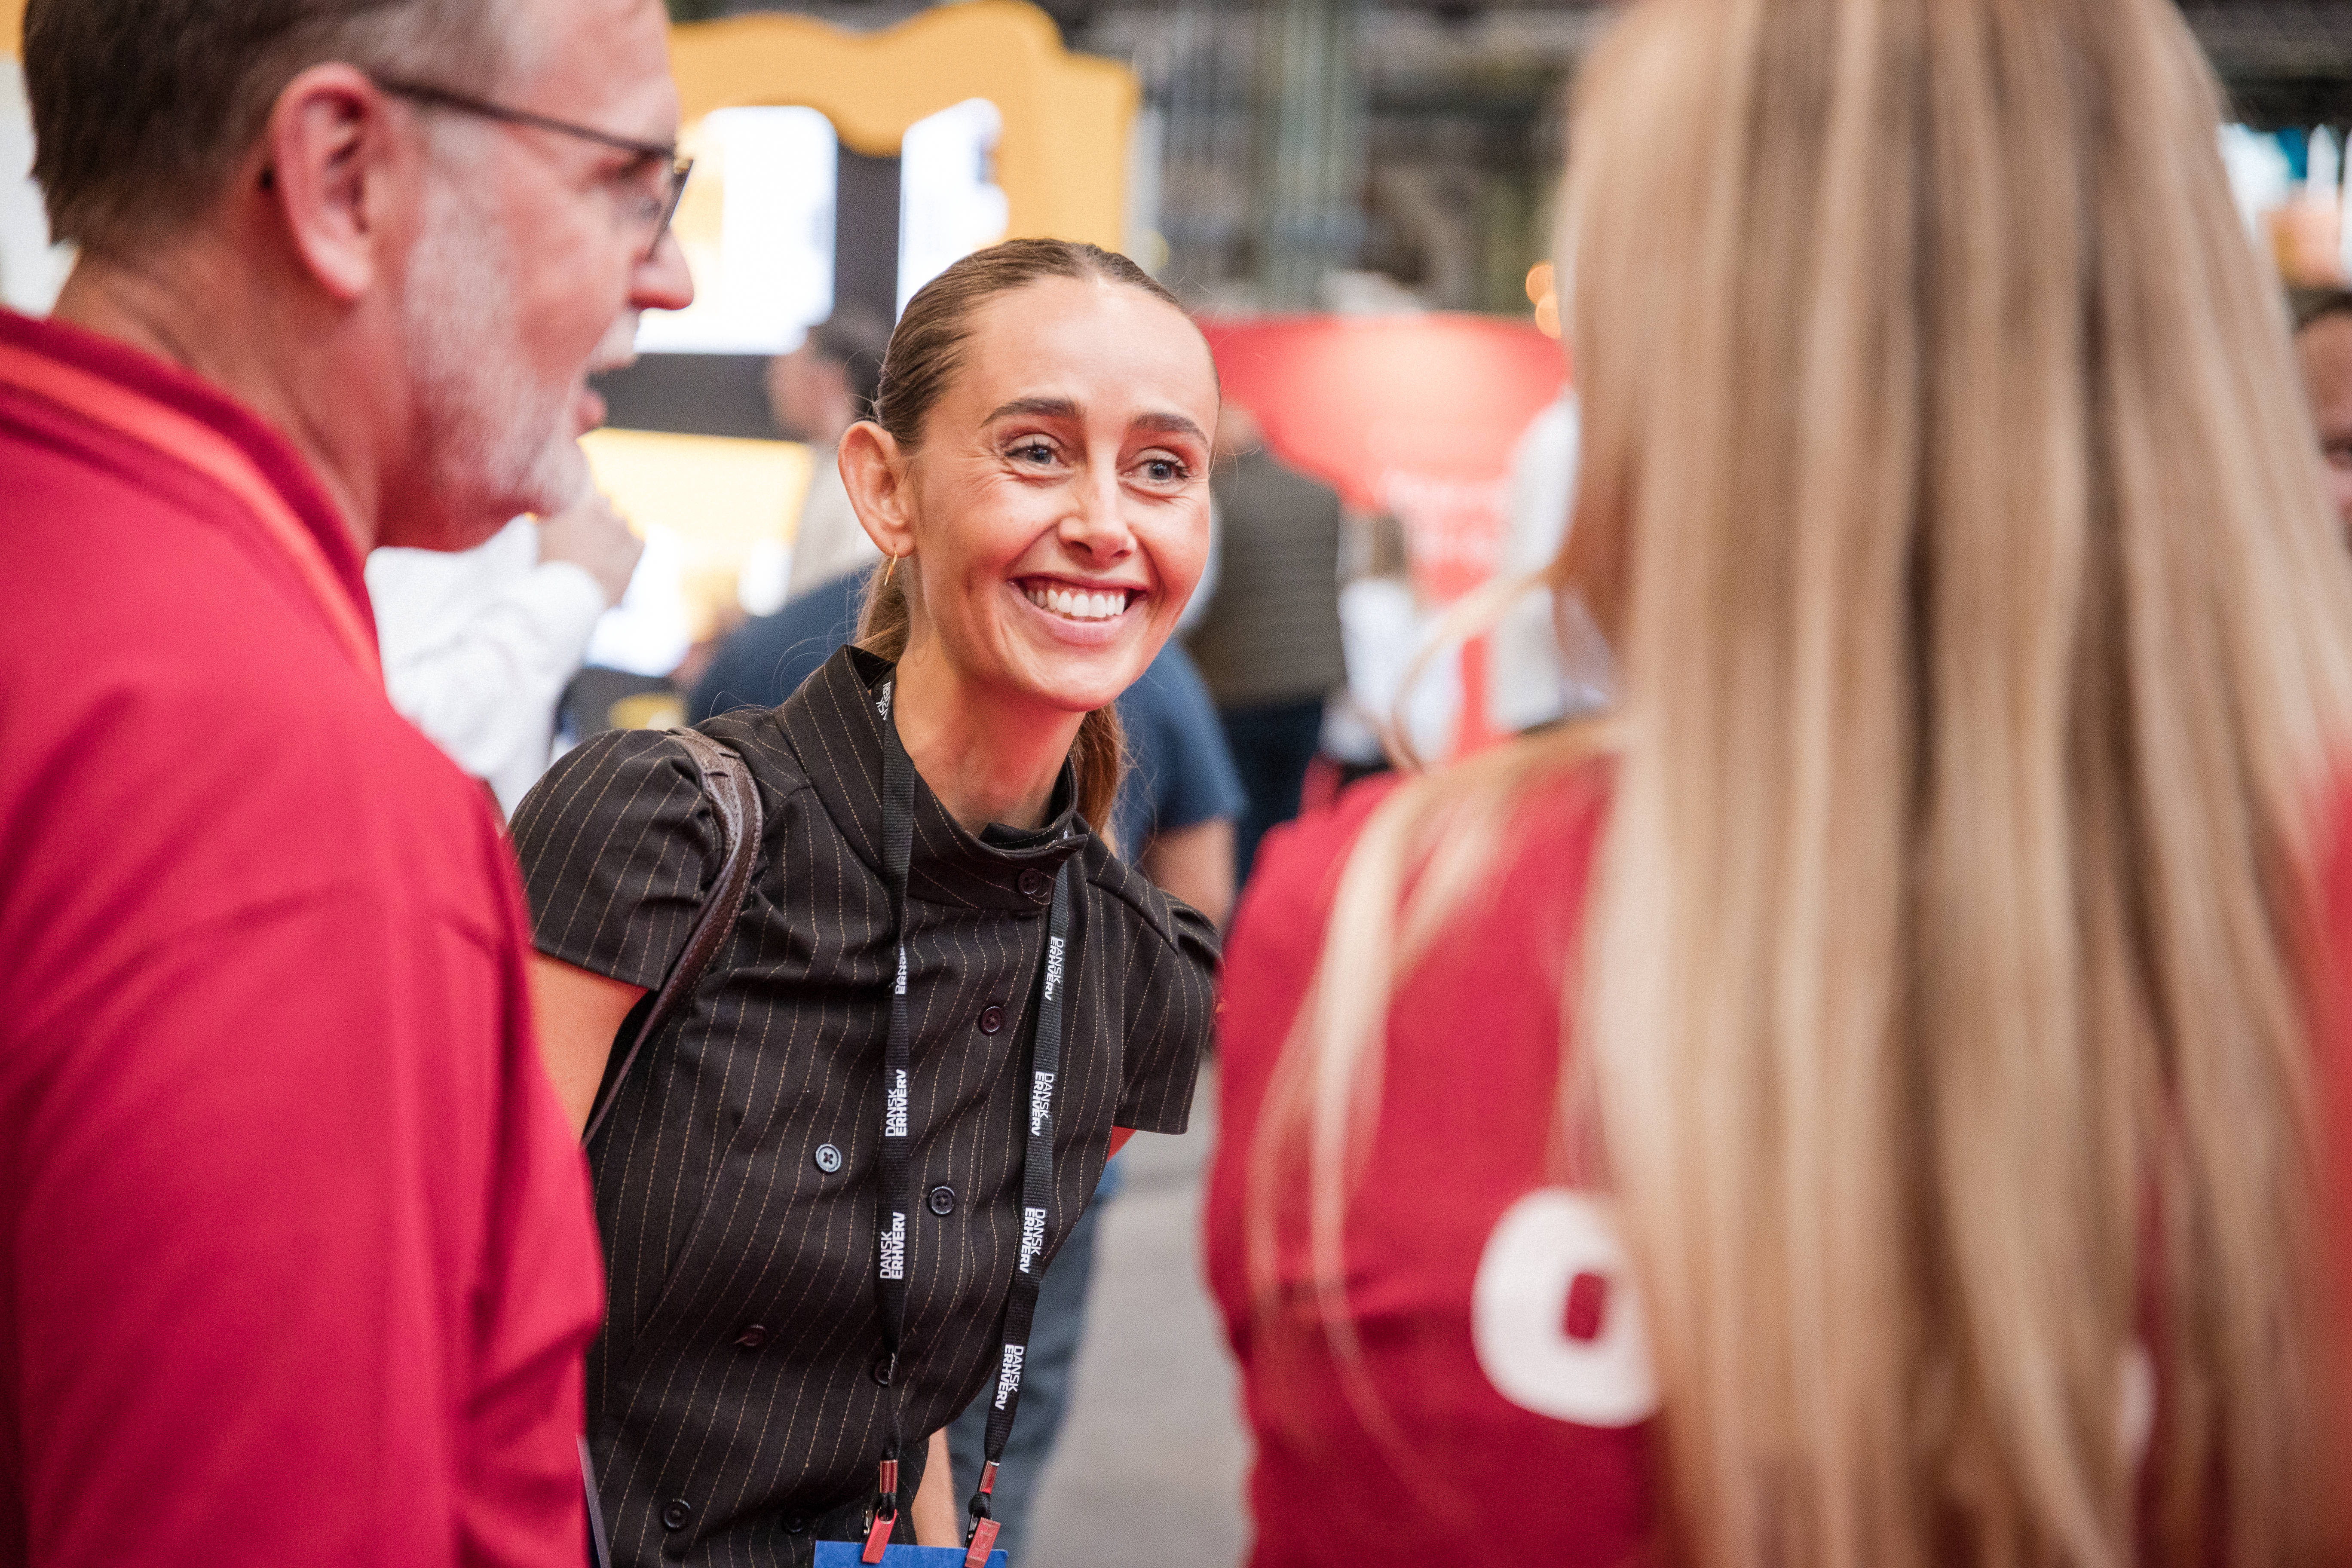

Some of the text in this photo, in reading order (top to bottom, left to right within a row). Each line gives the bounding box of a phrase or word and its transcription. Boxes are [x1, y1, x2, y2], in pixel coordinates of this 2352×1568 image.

[1044, 936, 1057, 1001] ERHVERV
[1053, 938, 1064, 984] DANSK
[885, 1088, 897, 1136] DANSK
[895, 1069, 907, 1136] ERHVERV
[1032, 1071, 1045, 1136] ERHVERV
[1040, 1073, 1054, 1119] DANSK
[880, 1231, 892, 1279] DANSK
[891, 1211, 905, 1280] ERHVERV
[1020, 1207, 1035, 1274] ERHVERV
[1030, 1209, 1045, 1256] DANSK
[995, 1344, 1014, 1410] ERHVERV
[1008, 1346, 1024, 1392] DANSK
